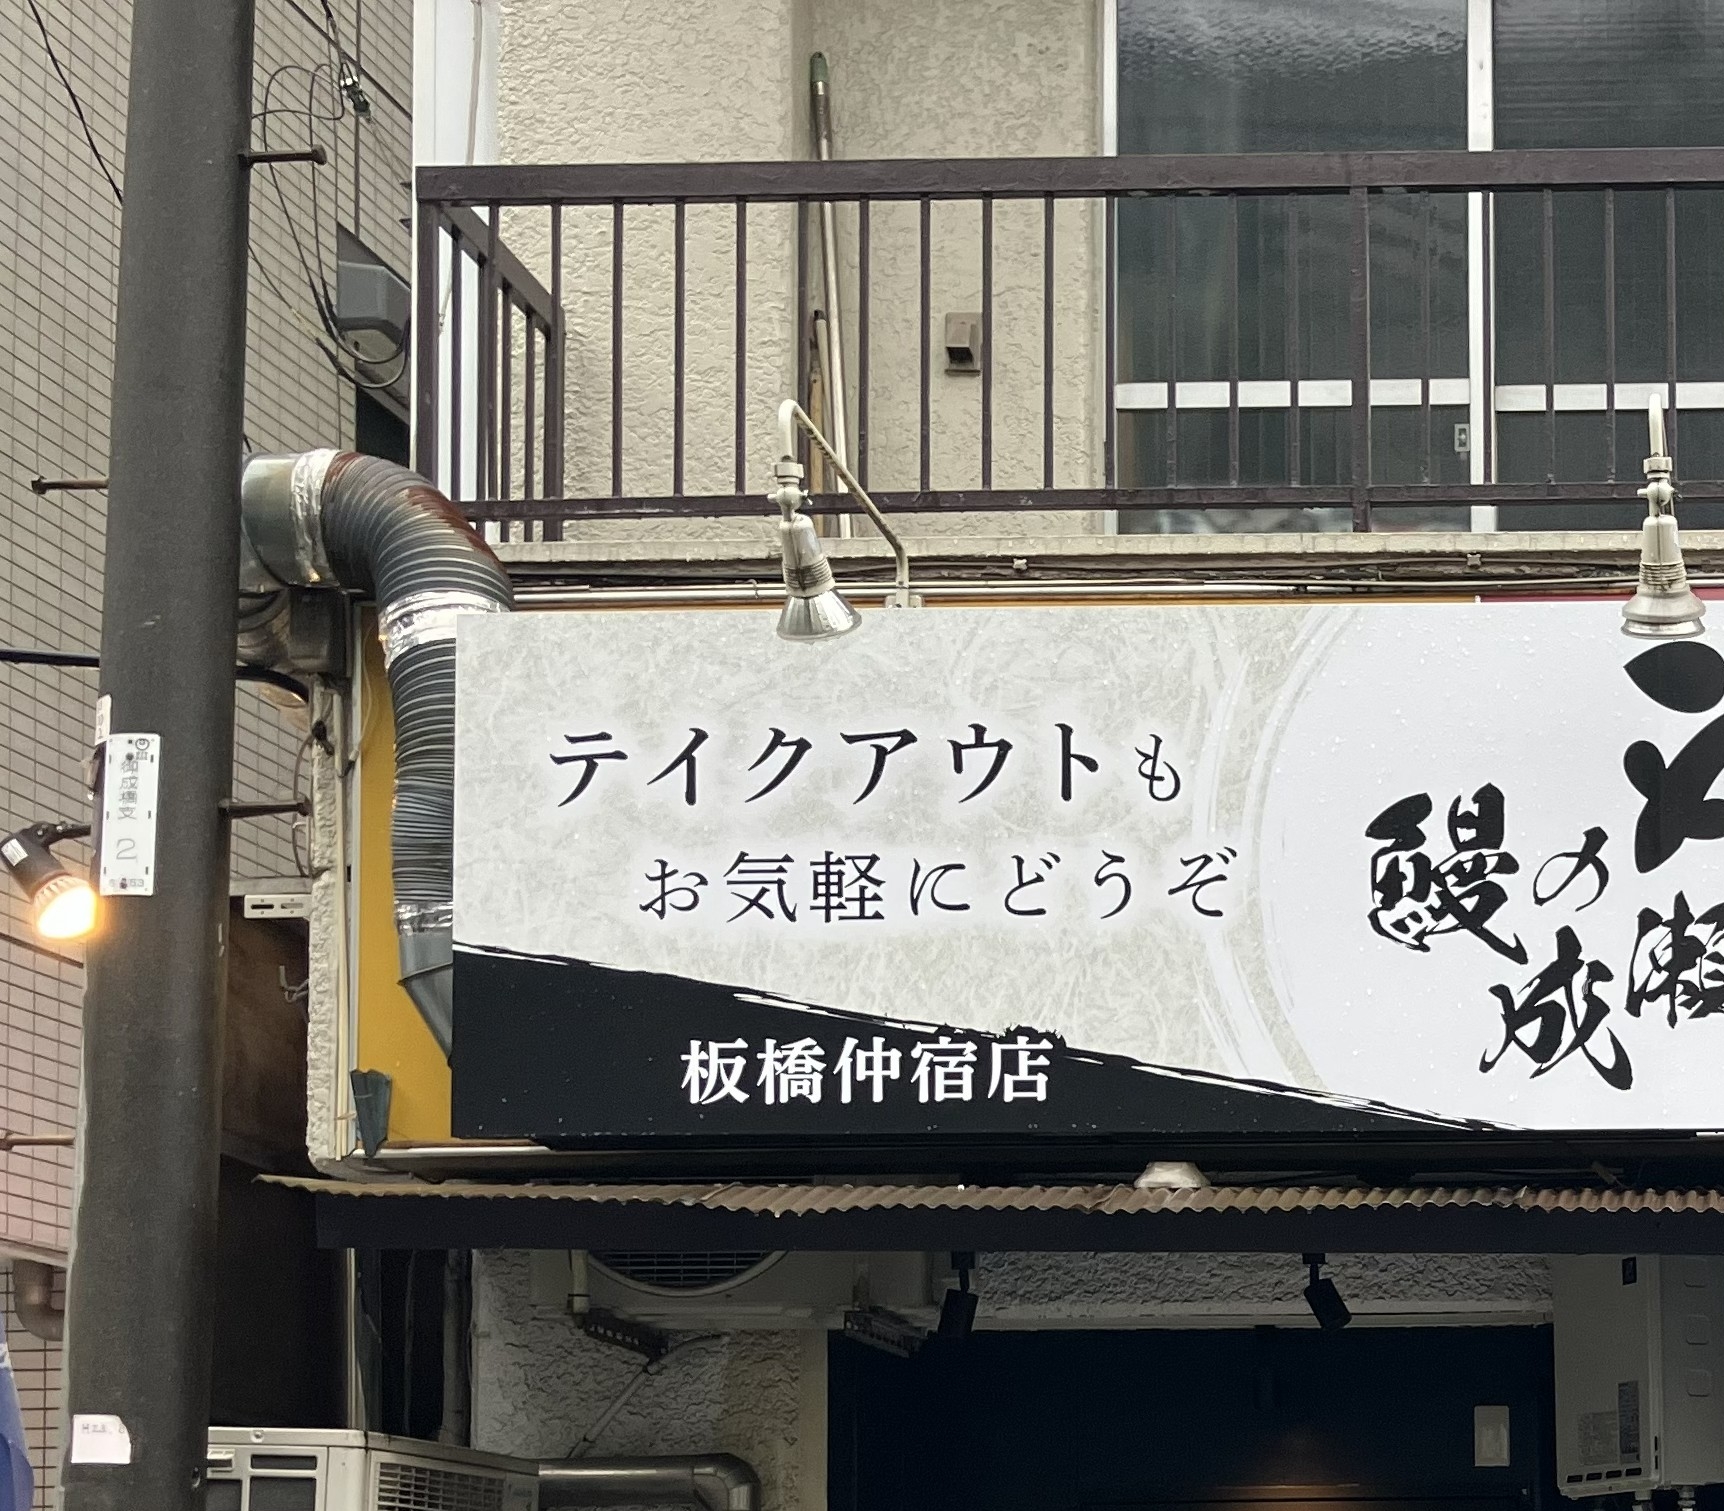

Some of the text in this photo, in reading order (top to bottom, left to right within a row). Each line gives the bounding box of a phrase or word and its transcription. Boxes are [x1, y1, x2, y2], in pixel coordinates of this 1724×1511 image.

[549, 722, 1183, 806] テイクアウトも
[116, 838, 138, 861] 2
[639, 847, 1237, 923] お気軽にどうぞ
[680, 1037, 1053, 1105] 板橋仲宿店
